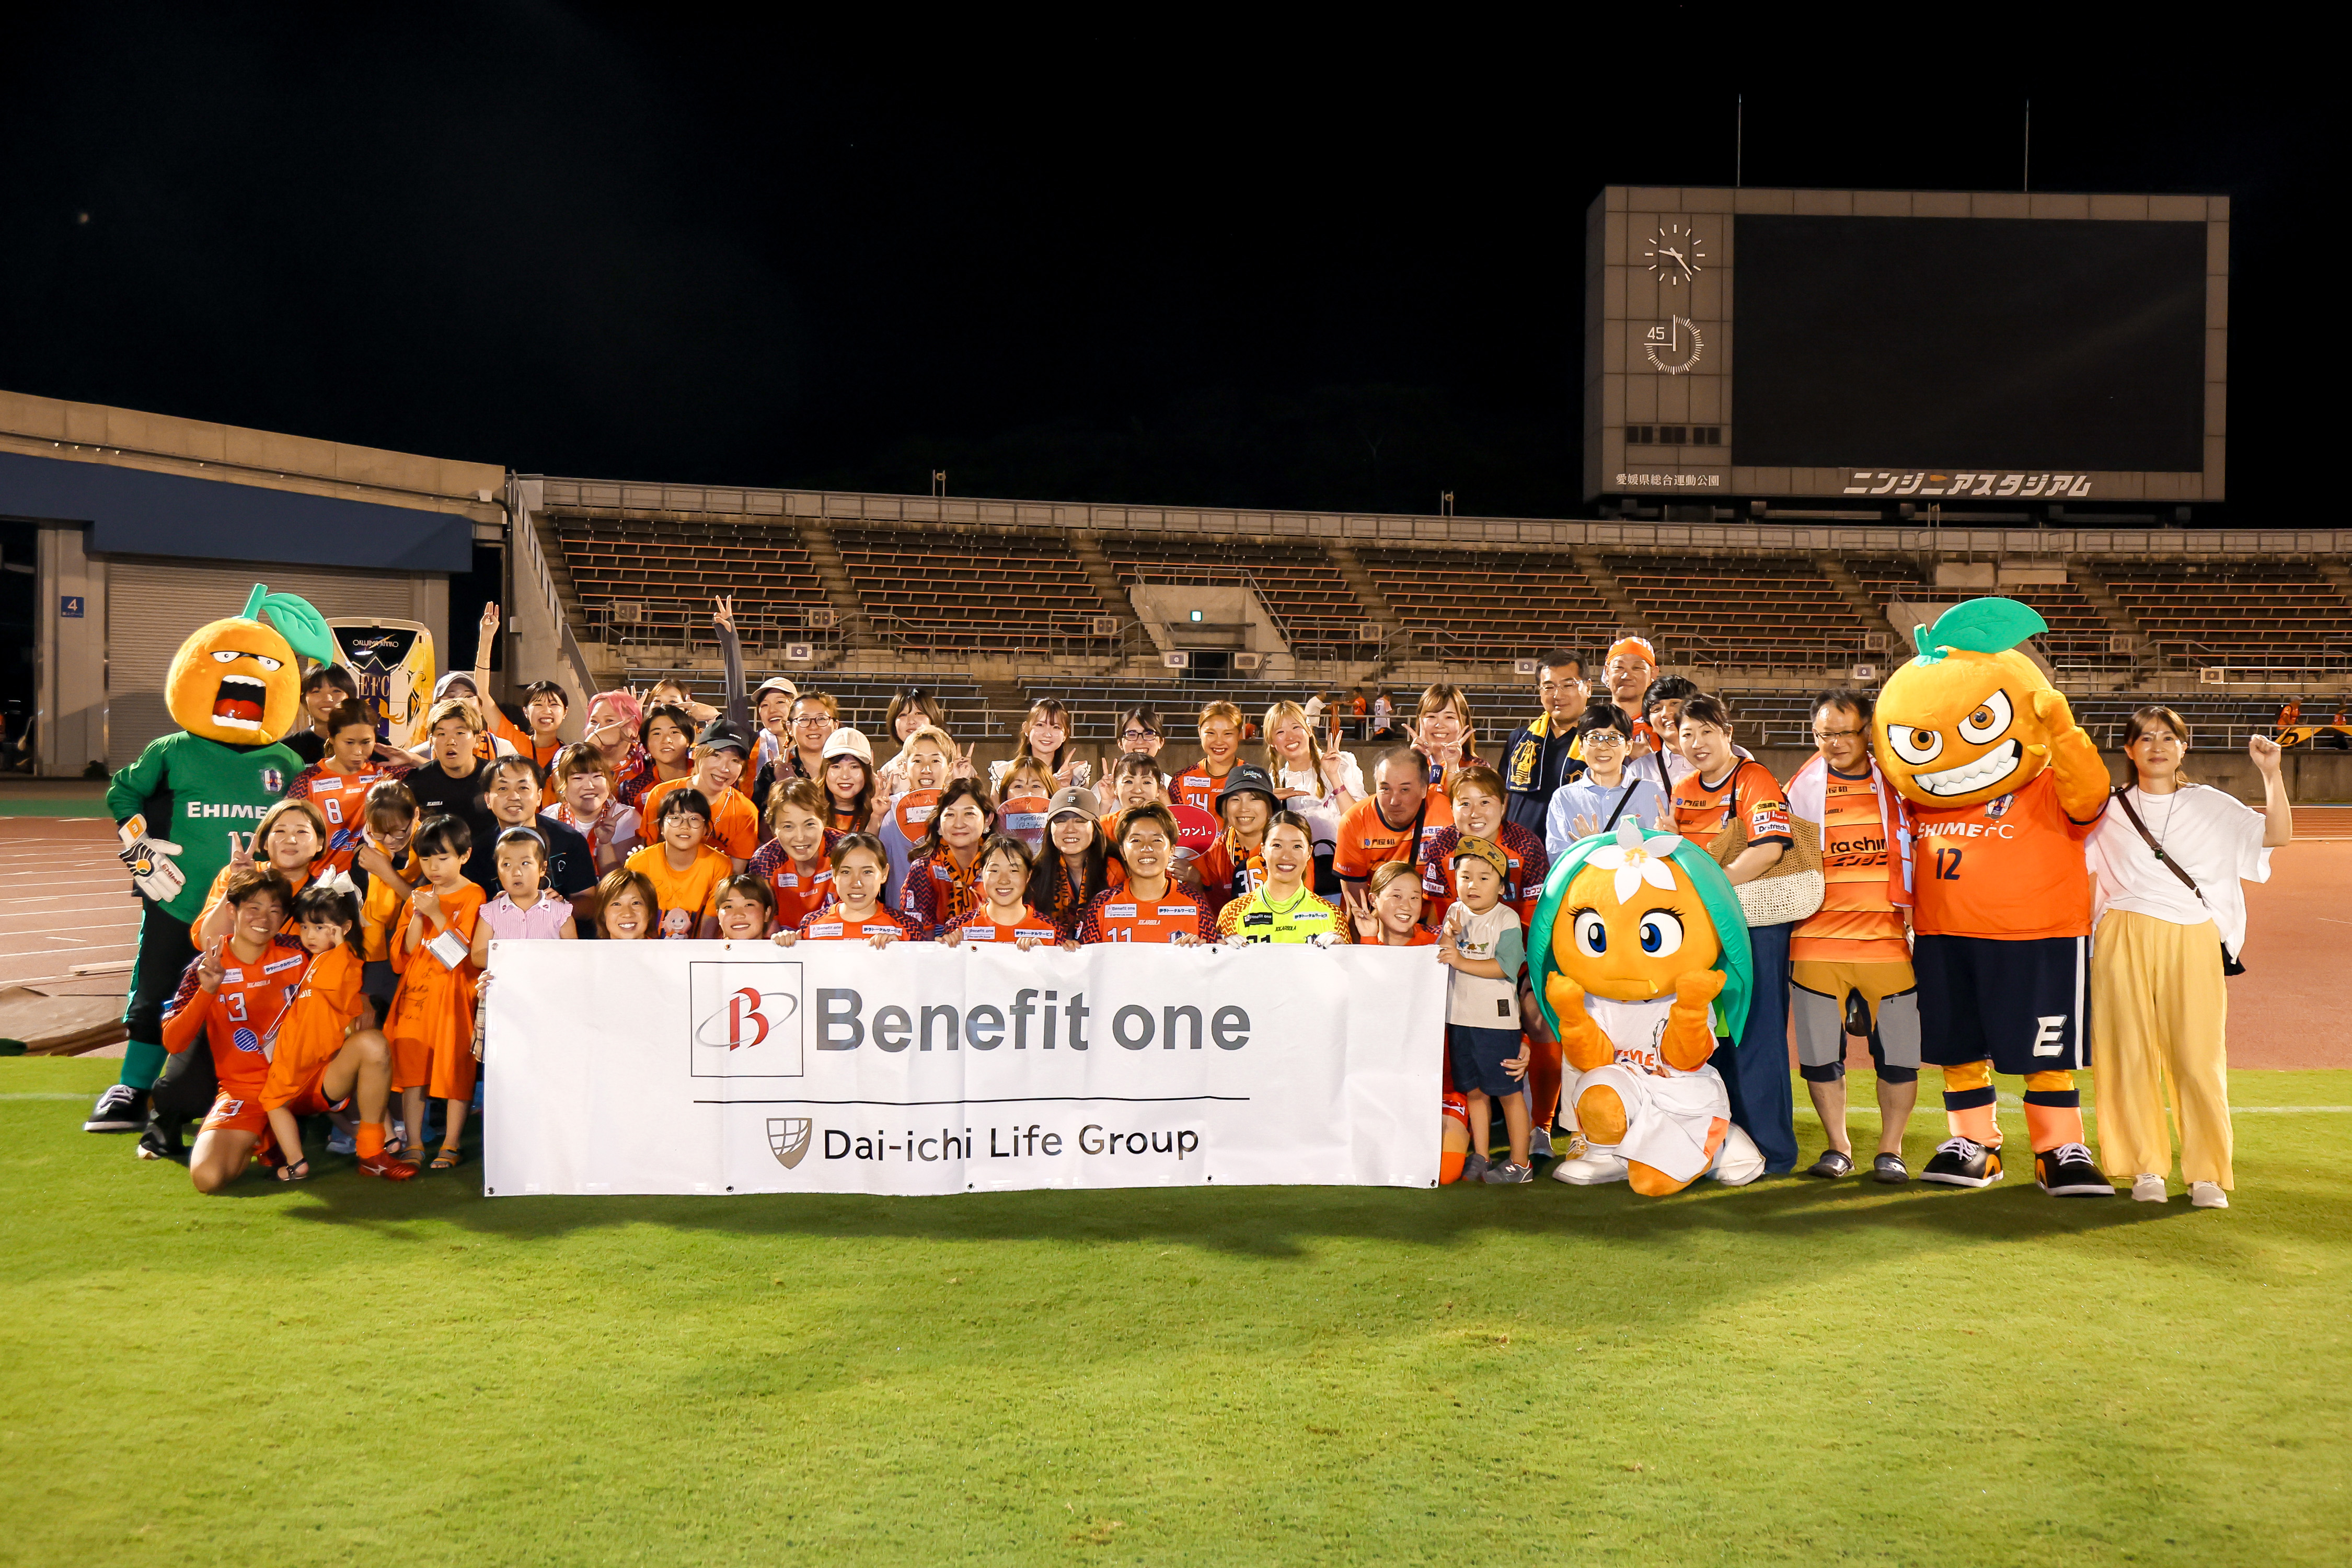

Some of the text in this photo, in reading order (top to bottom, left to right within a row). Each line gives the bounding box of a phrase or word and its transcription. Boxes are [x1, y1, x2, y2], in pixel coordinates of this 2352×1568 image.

[1647, 327, 1665, 340] 45
[1616, 474, 1719, 486] 愛媛県総合運動公園
[1843, 472, 2091, 497] ニンジニアスタジアム
[67, 598, 78, 611] 4
[360, 675, 390, 697] EFC
[1433, 769, 1440, 778] 14
[188, 802, 268, 819] EHIME
[324, 798, 343, 824] 8
[162, 863, 182, 885] EHIME
[1936, 848, 1962, 880] 12
[816, 988, 1251, 1052] Benefit one
[2032, 1014, 2067, 1057] E
[824, 1124, 1199, 1162] Dai-ichi Life Group
